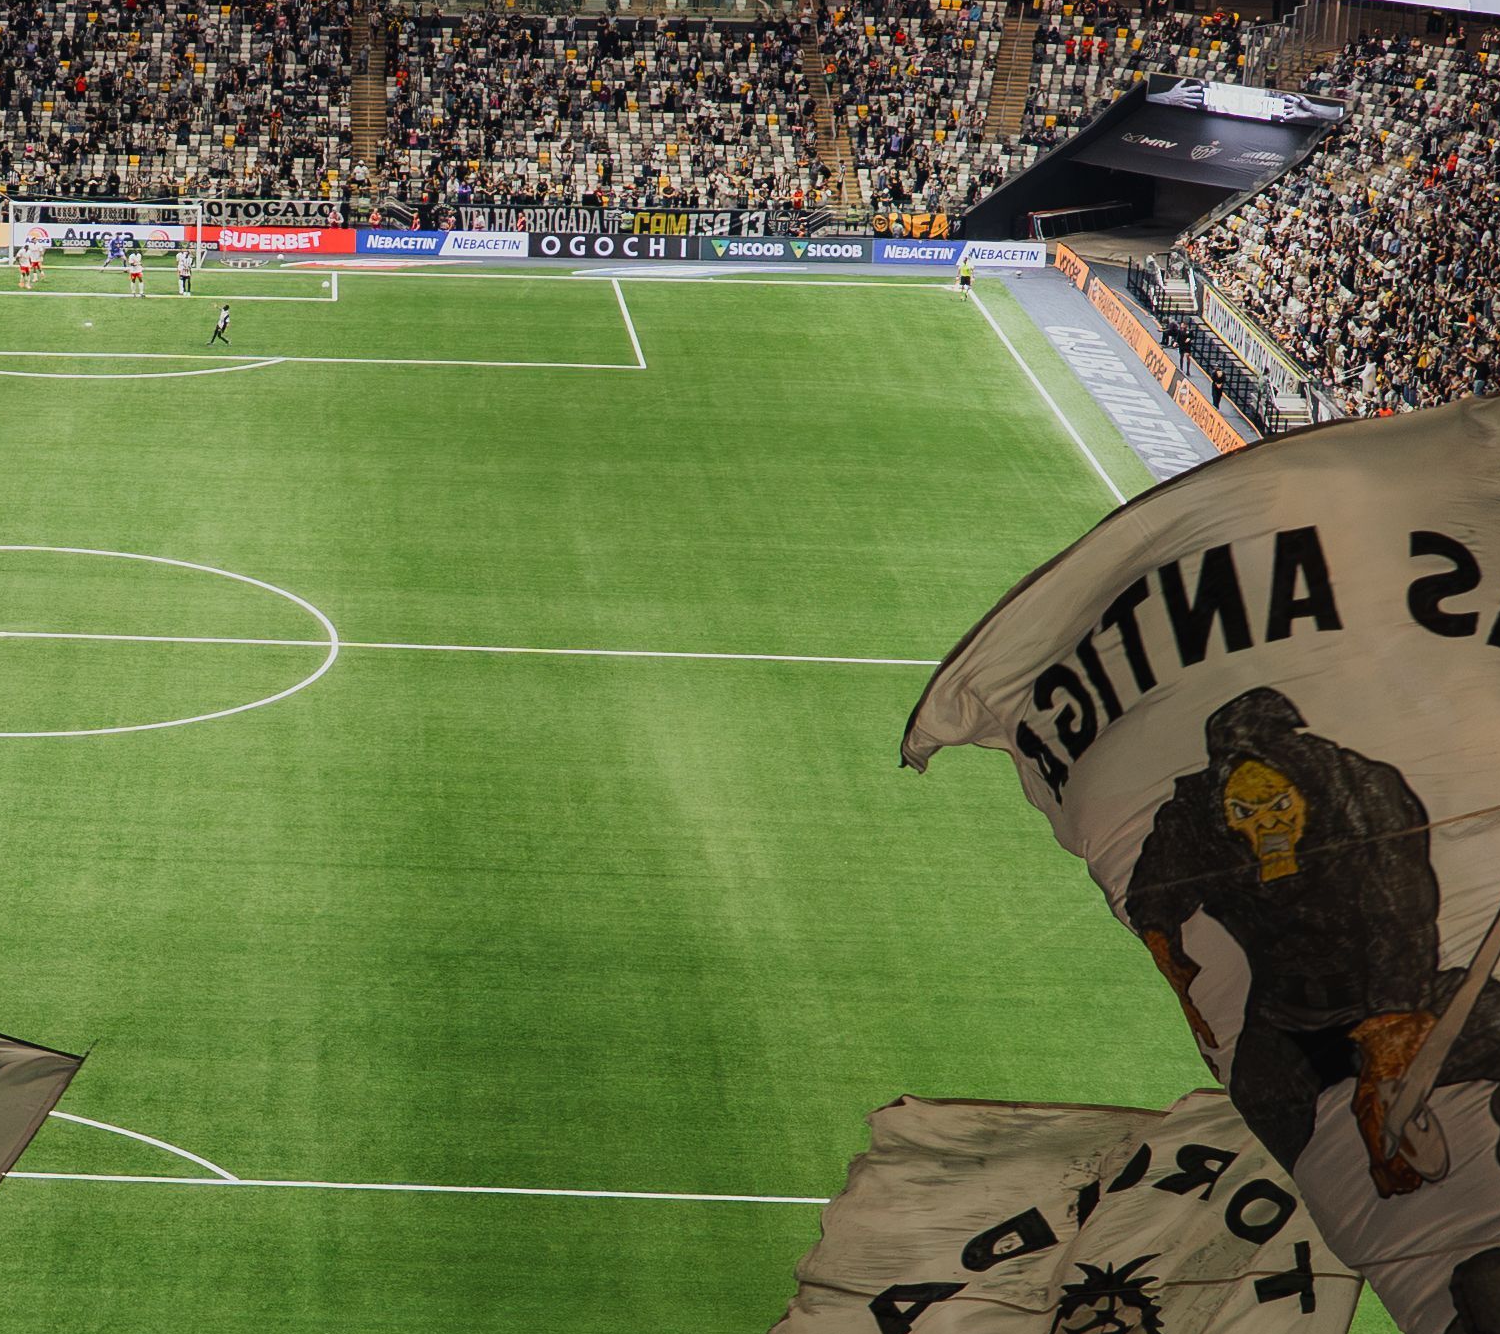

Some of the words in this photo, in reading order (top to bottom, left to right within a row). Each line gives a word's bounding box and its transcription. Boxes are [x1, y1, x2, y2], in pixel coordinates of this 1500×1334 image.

[1137, 135, 1178, 150] MRV
[525, 207, 602, 233] BRIGADA
[219, 230, 322, 252] SUPERBET
[366, 234, 439, 251] NEBACETIN
[452, 236, 522, 251] NEBACETIN
[729, 242, 784, 257] SICOOB
[808, 243, 863, 258] SICOOB
[883, 245, 954, 260] NEBACETIN
